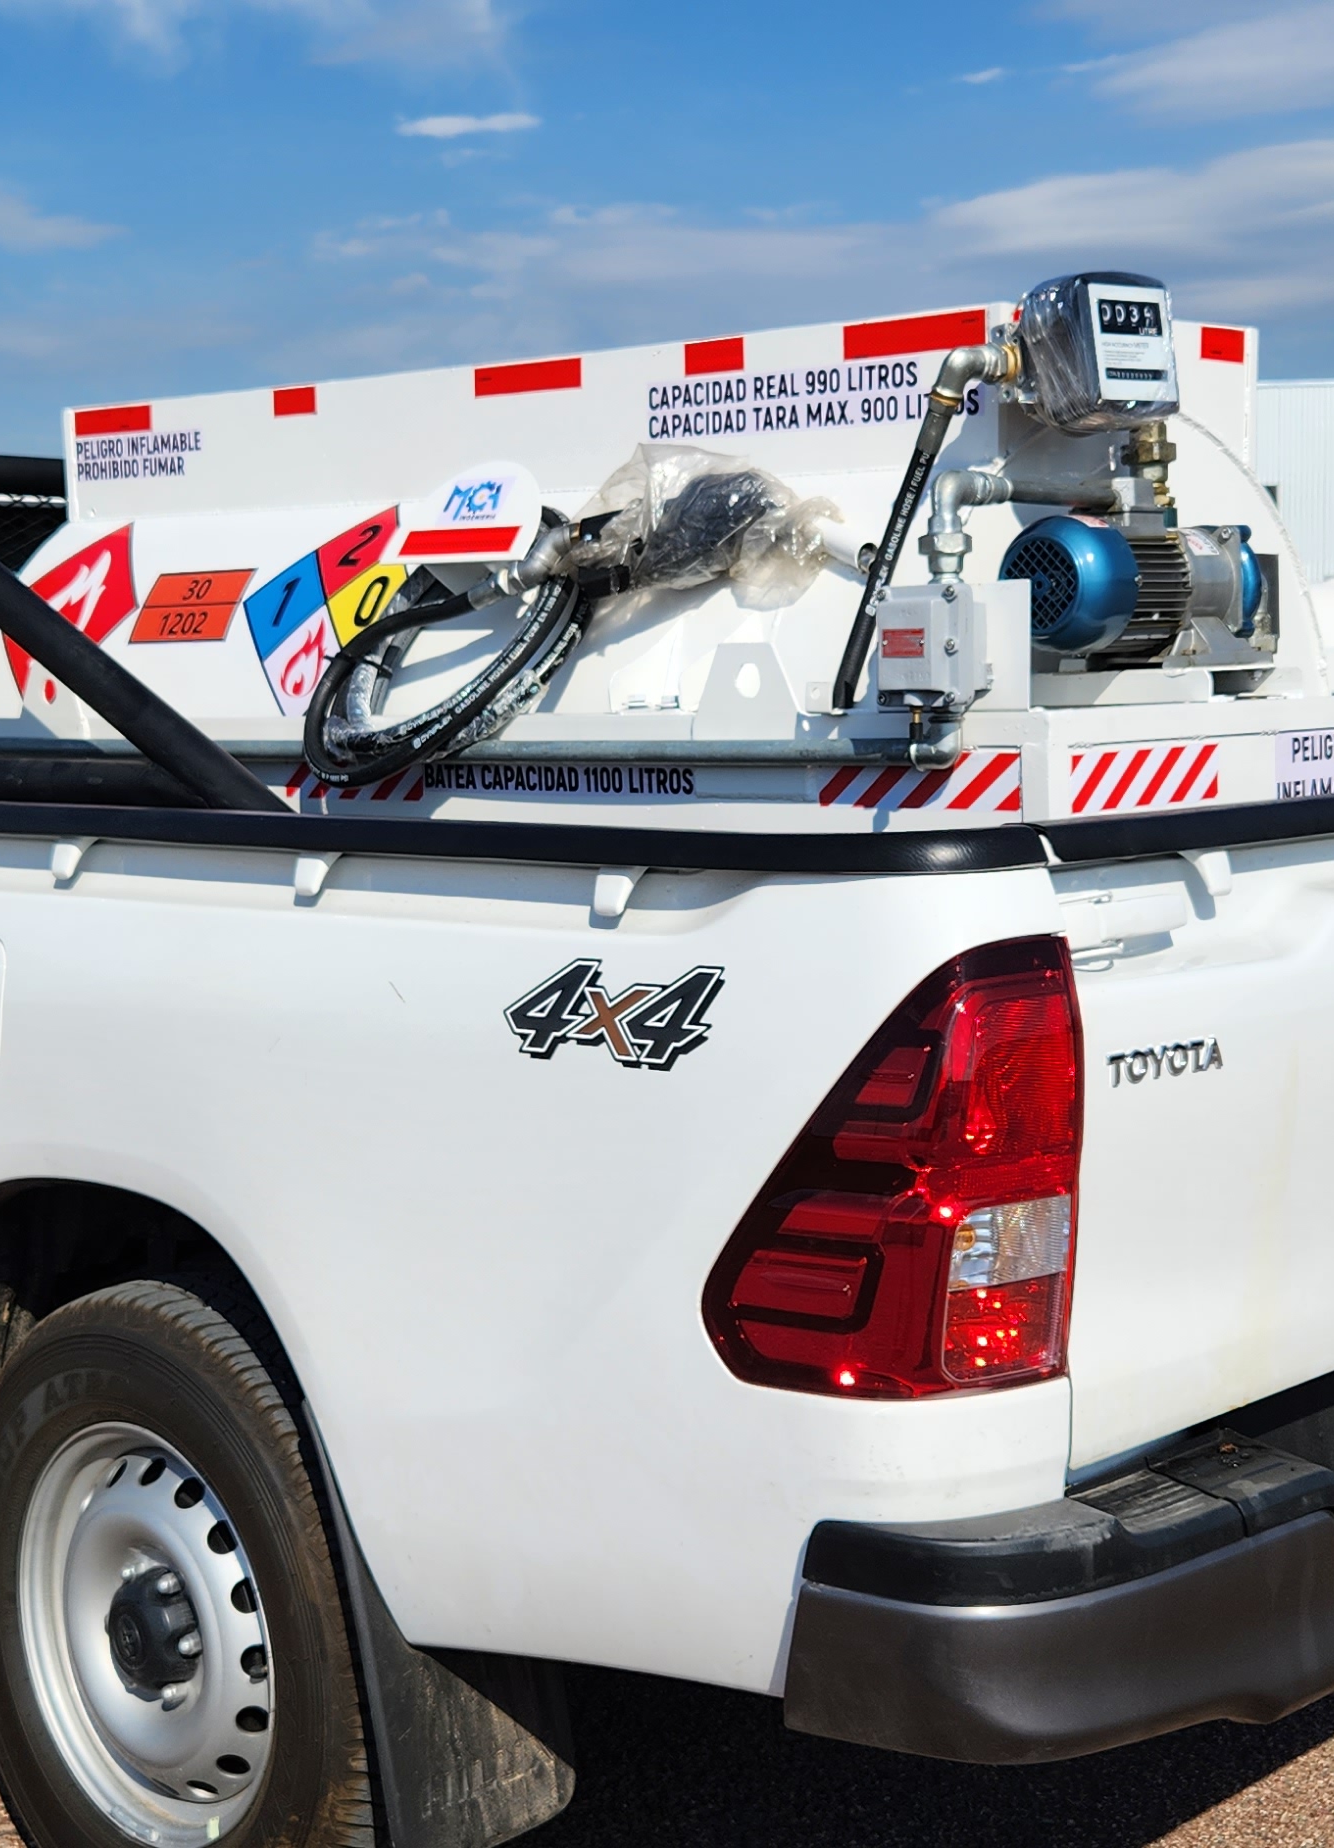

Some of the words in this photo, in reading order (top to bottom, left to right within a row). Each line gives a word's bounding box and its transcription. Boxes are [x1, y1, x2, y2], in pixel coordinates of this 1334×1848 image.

[648, 379, 746, 411] CAPACIDAD
[753, 375, 800, 401] REAL
[805, 368, 840, 396] 990
[847, 361, 918, 393] LITROS
[648, 408, 746, 439] CAPACIDAD
[753, 403, 800, 432] TARA
[806, 400, 854, 428] MAX.
[860, 395, 898, 422] 900
[76, 438, 124, 461] PELIGRO
[127, 431, 202, 457] INFLAMABLE
[77, 459, 139, 482] PROHIBIDO
[143, 456, 185, 478] FUMAR
[884, 516, 906, 562] GASOLINE
[900, 491, 916, 517] HOSE
[910, 464, 926, 488] FUEL
[336, 524, 383, 567] 2
[182, 578, 213, 601] 30
[271, 577, 302, 628] 1
[353, 575, 390, 627] 0
[158, 611, 209, 637] 1202
[423, 763, 475, 790] BATEA
[480, 764, 579, 793] CAPACIDAD
[583, 766, 623, 794] 1100
[629, 767, 695, 796] LITROS
[1105, 1034, 1224, 1089] TOYOTA
